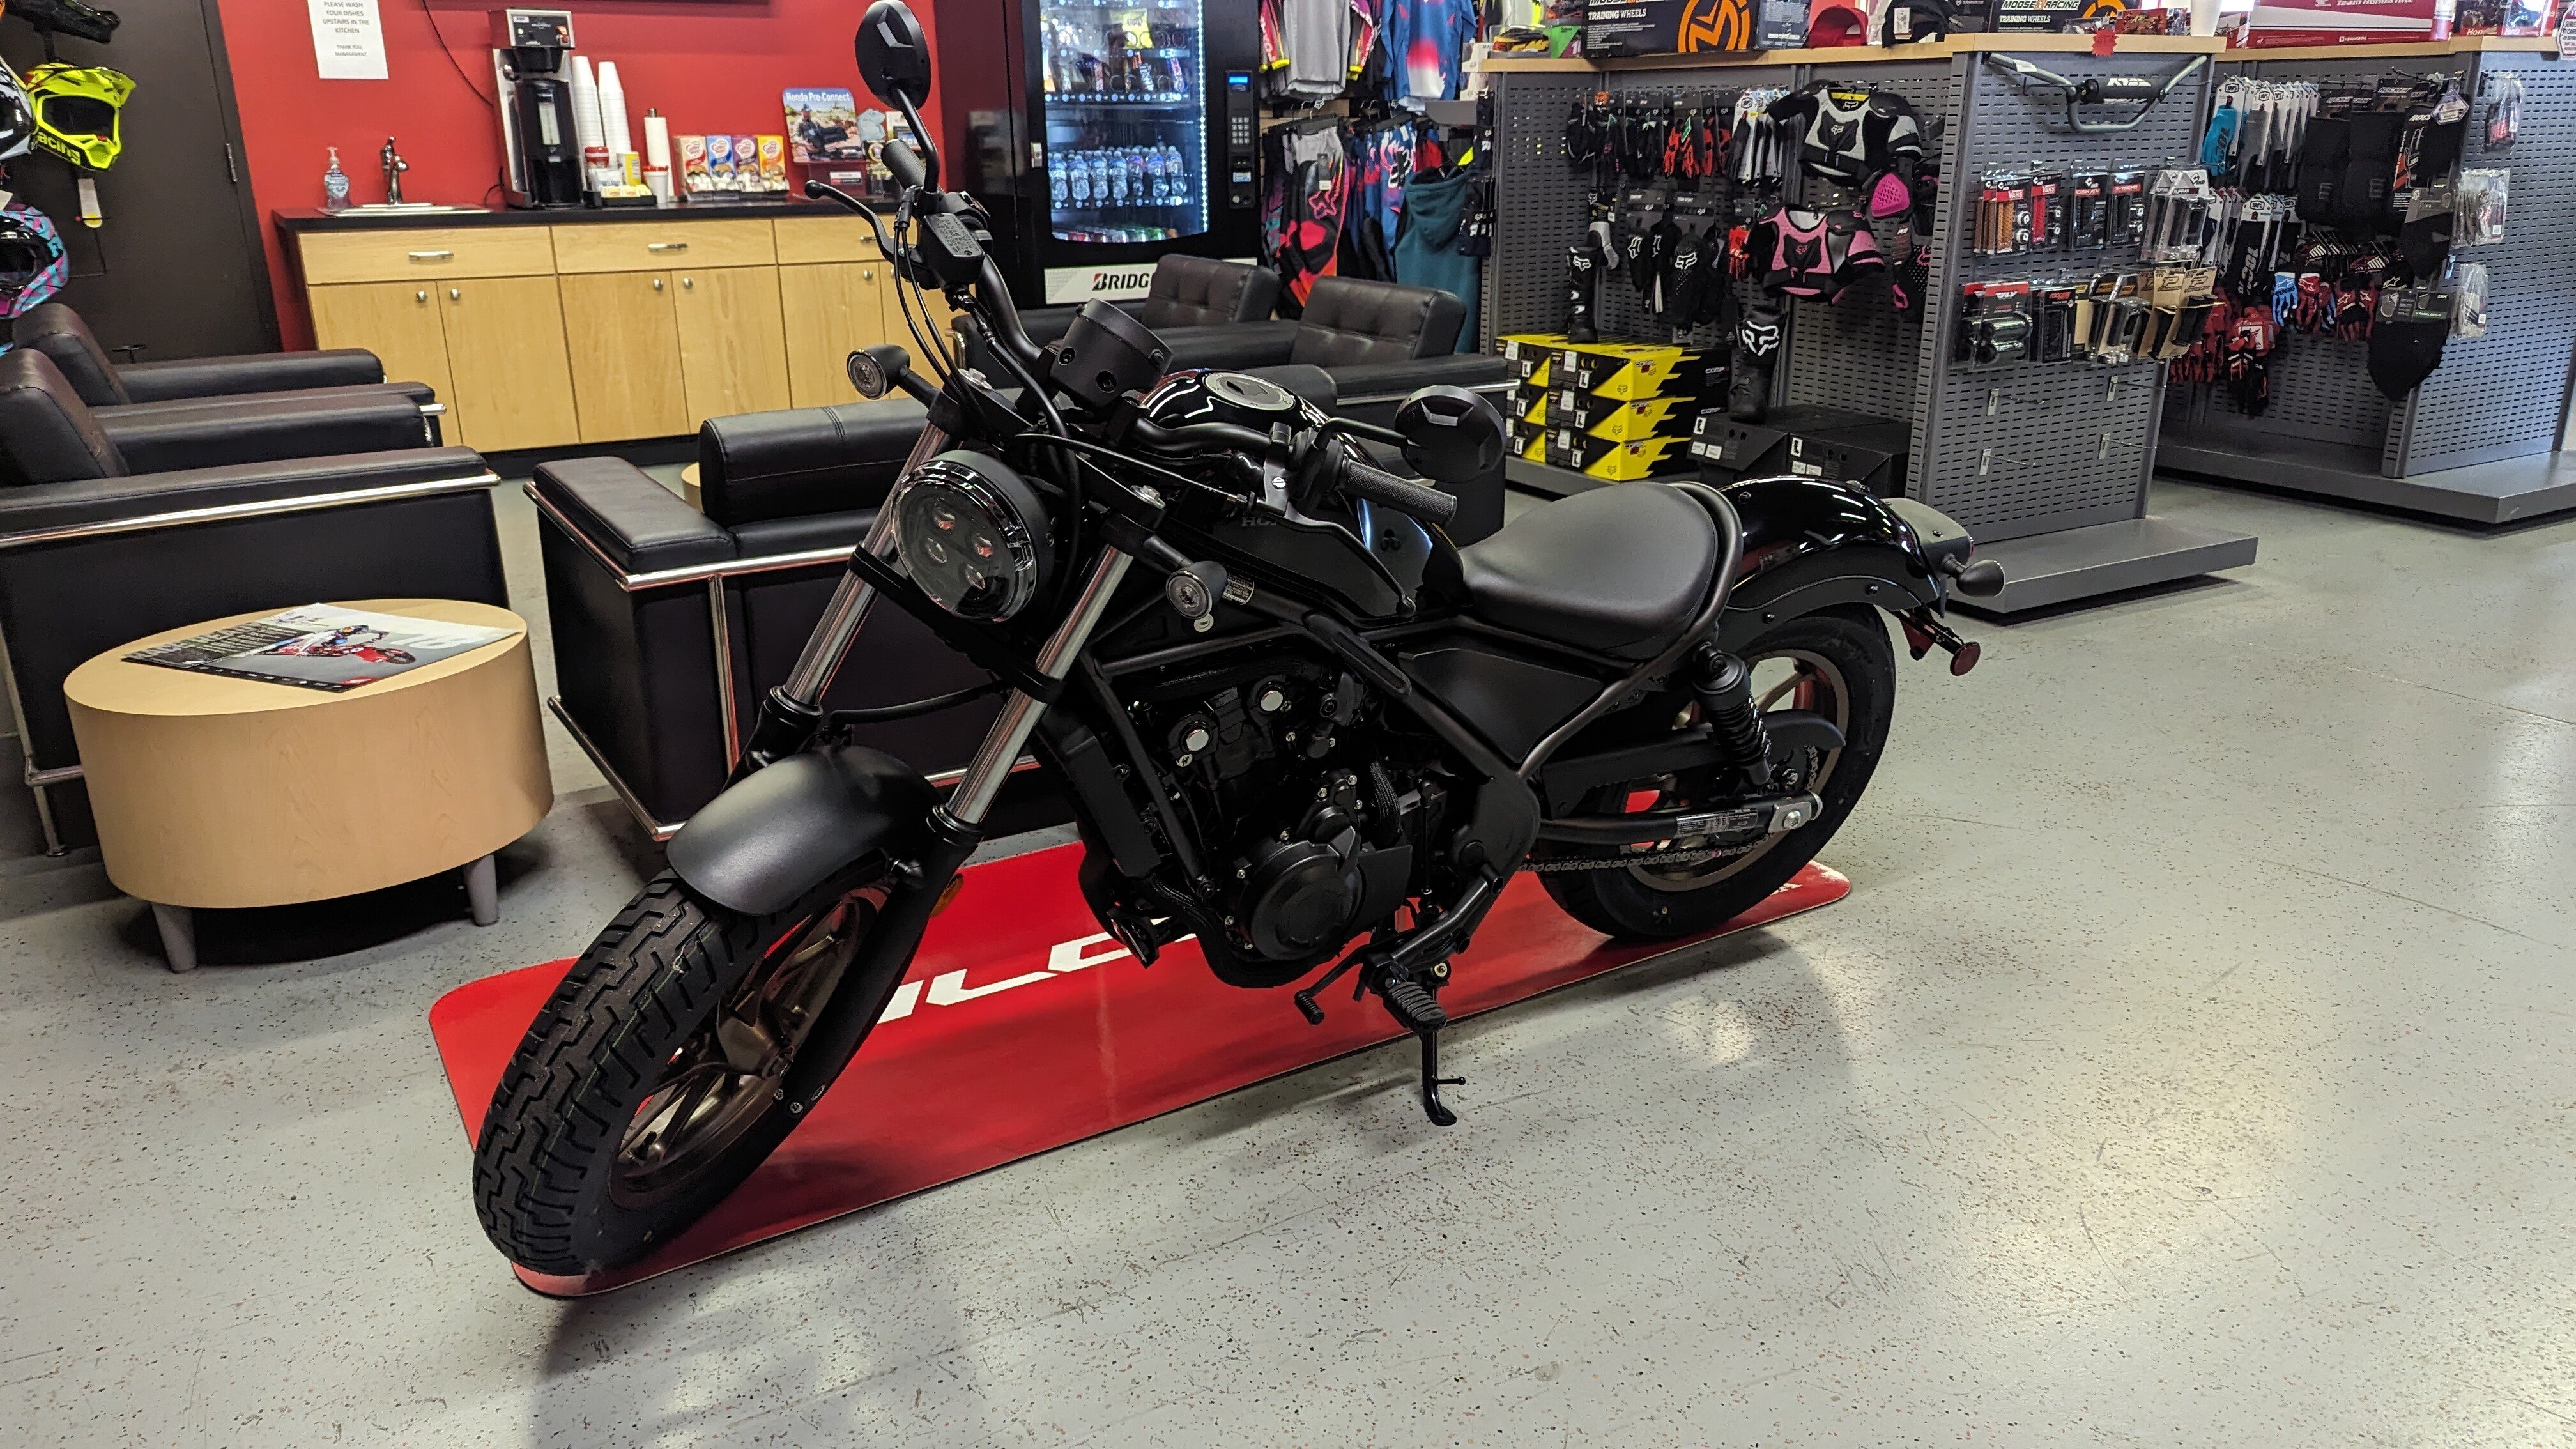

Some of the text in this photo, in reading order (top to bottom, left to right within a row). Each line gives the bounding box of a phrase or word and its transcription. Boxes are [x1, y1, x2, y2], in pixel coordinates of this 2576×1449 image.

[2001, 1, 2080, 10] MOOSE RACING
[1588, 8, 1647, 20] TRAINING WHEELS
[786, 92, 808, 102] Honda
[2009, 190, 2023, 199] VANS
